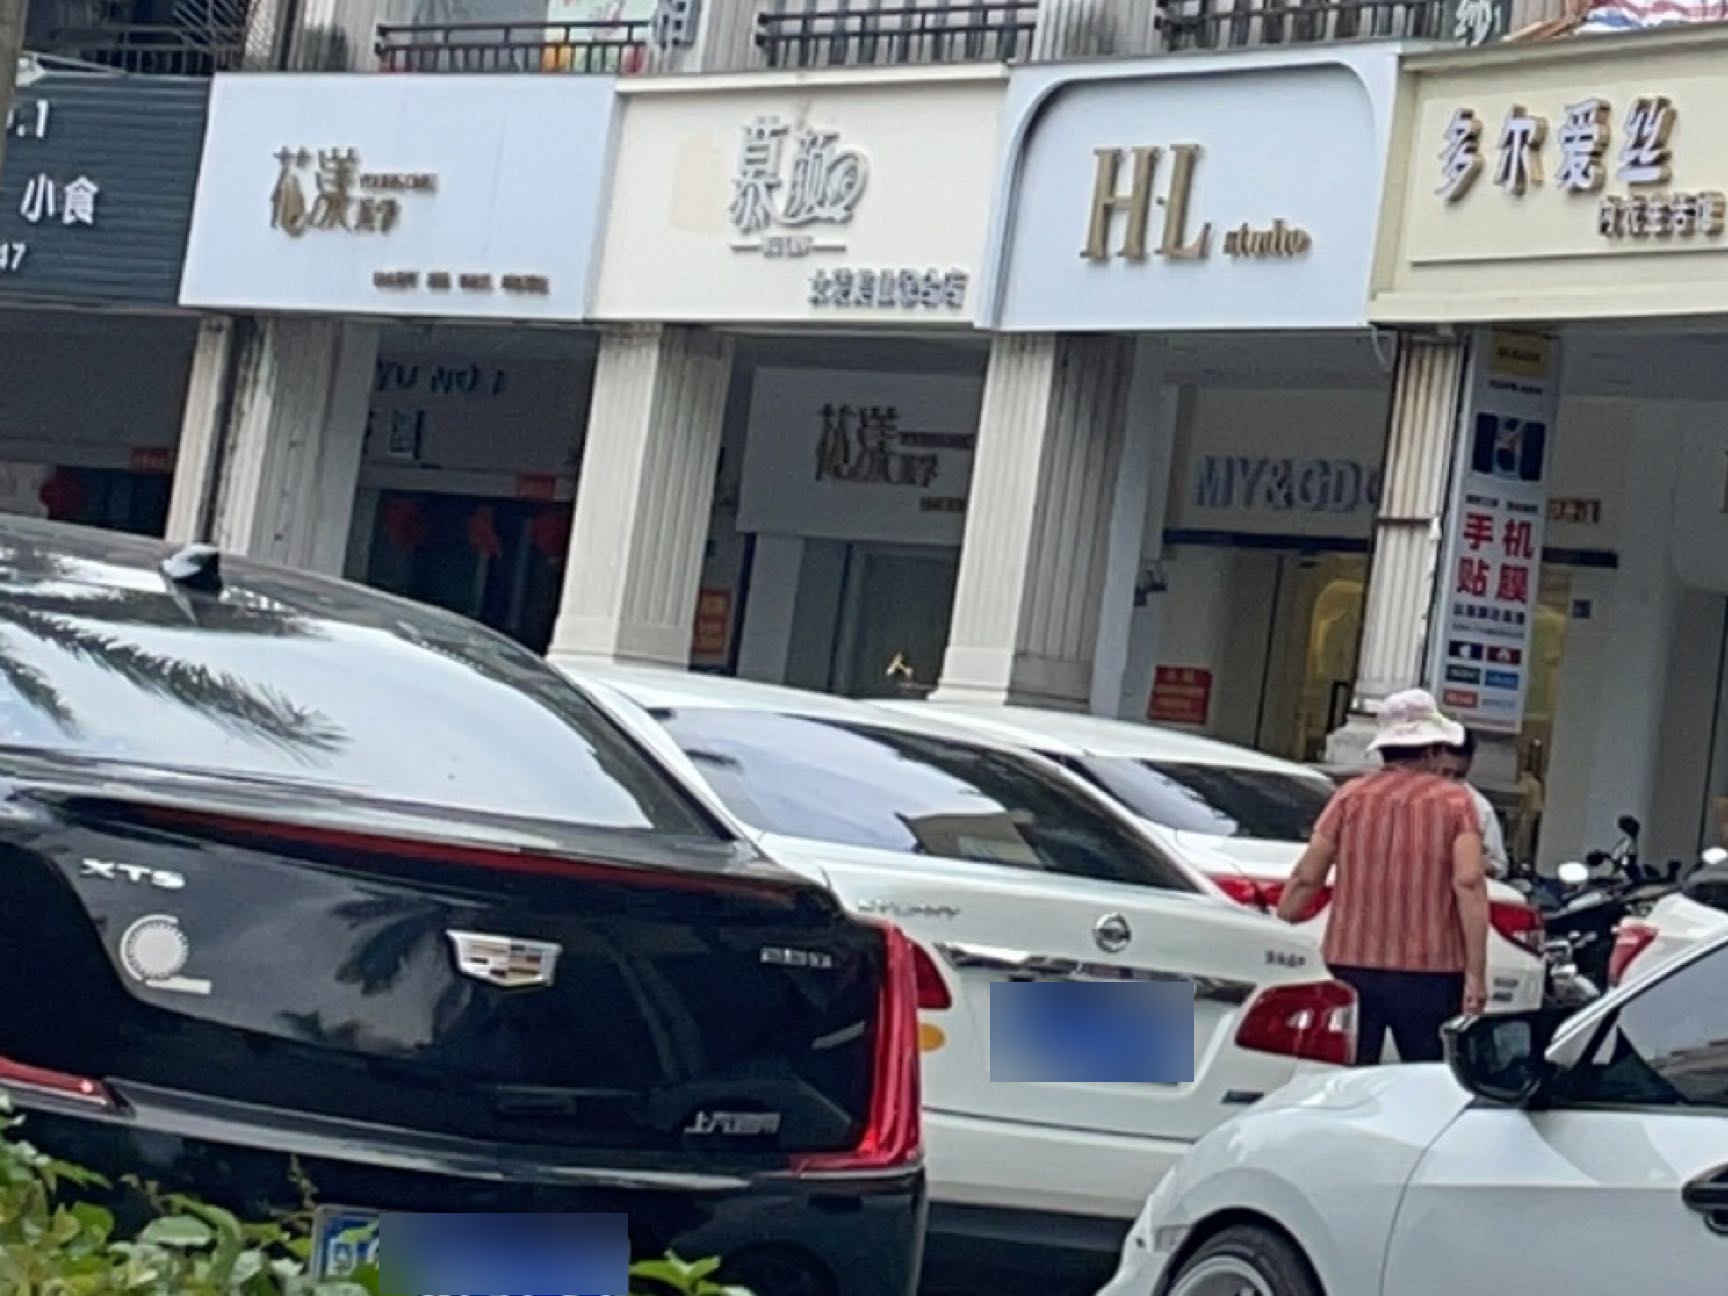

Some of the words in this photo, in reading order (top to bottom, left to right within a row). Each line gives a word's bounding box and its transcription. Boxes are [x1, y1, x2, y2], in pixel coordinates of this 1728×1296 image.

[1436, 96, 1678, 203] 多尔爱丝
[20, 173, 100, 225] 小食
[1462, 512, 1536, 560] 手机
[1455, 558, 1529, 605] 贴膜
